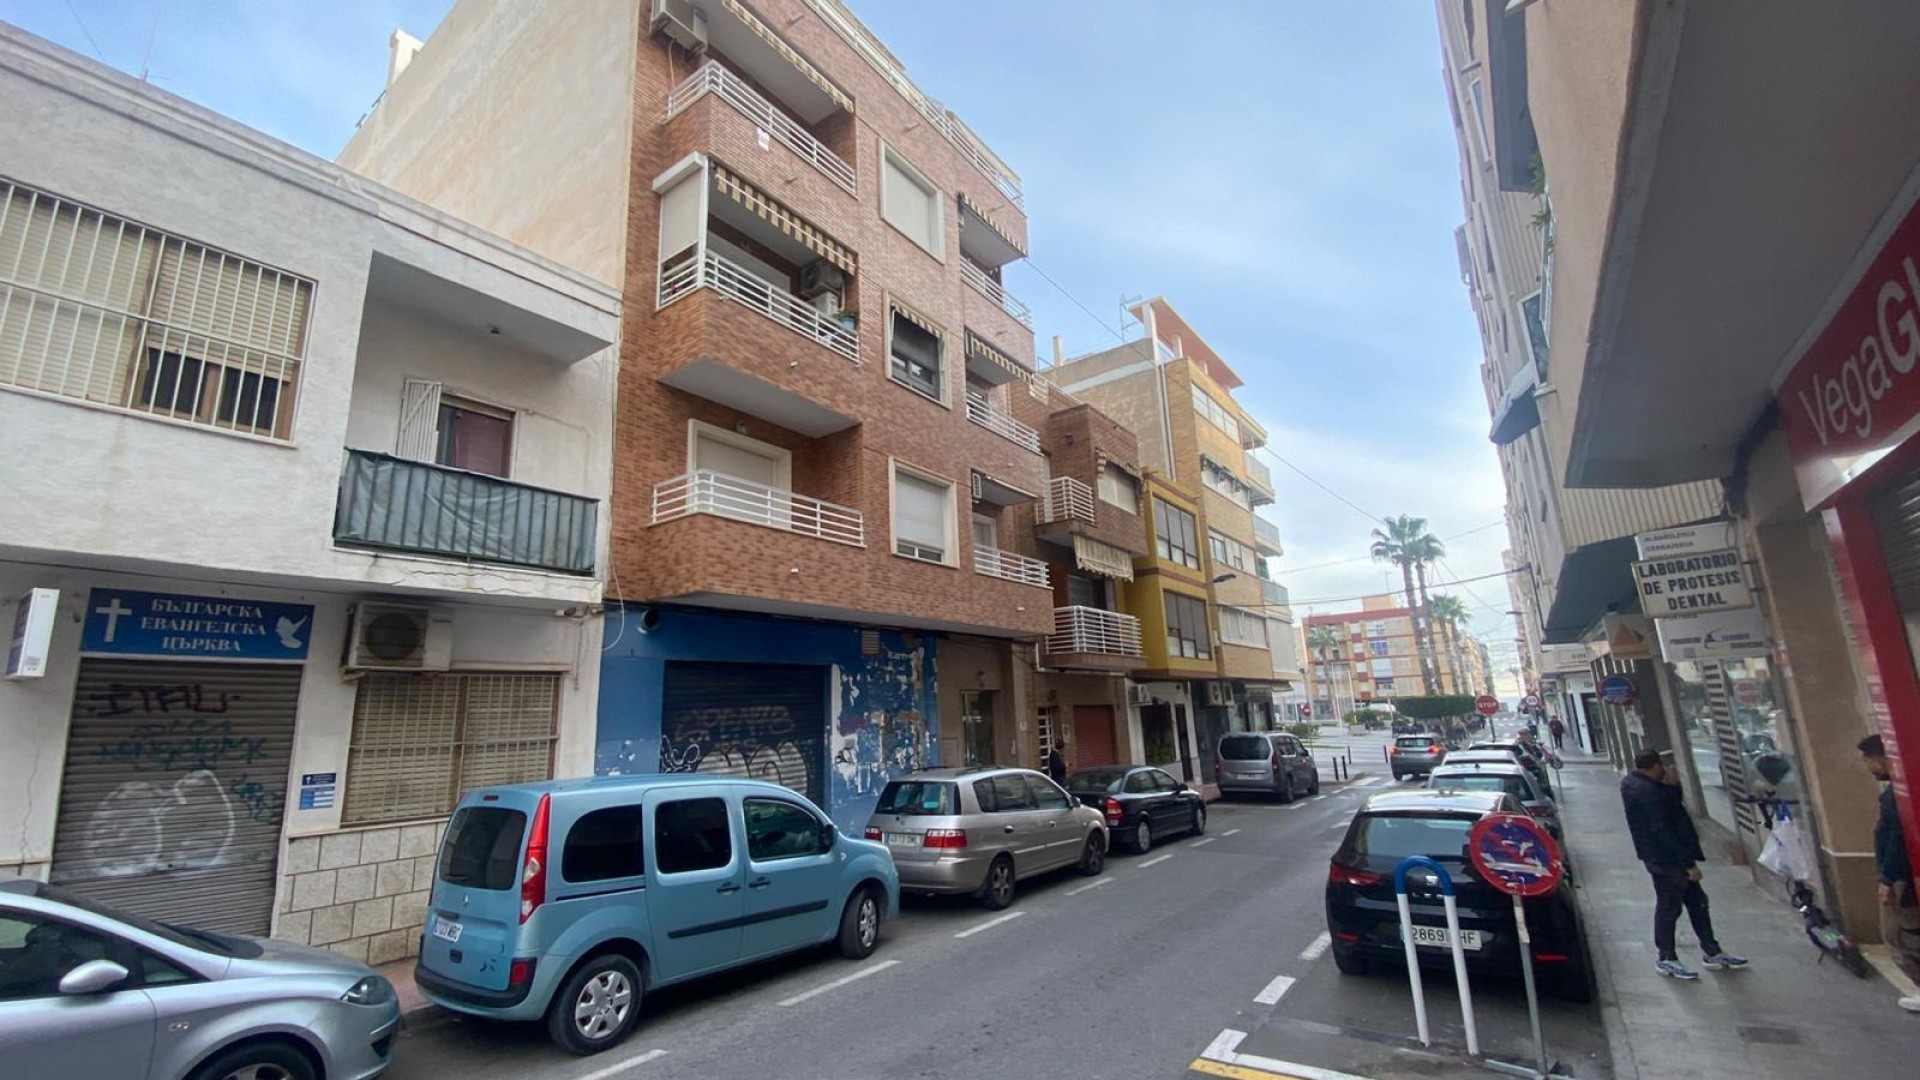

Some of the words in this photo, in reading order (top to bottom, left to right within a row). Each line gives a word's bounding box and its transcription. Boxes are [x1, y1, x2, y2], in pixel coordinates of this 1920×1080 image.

[1638, 552, 1738, 578] LABORATORIO
[1643, 581, 1663, 595] DE
[1668, 570, 1740, 592] PROTESIS
[151, 599, 263, 619] БЪЛГАРСКА
[1667, 592, 1728, 611] DENTAL
[140, 617, 267, 636] ЕВАНГЕЛСКА
[162, 636, 242, 652] ЦЪРКВА
[1477, 701, 1497, 709] STOP
[1411, 926, 1445, 942] 2869
